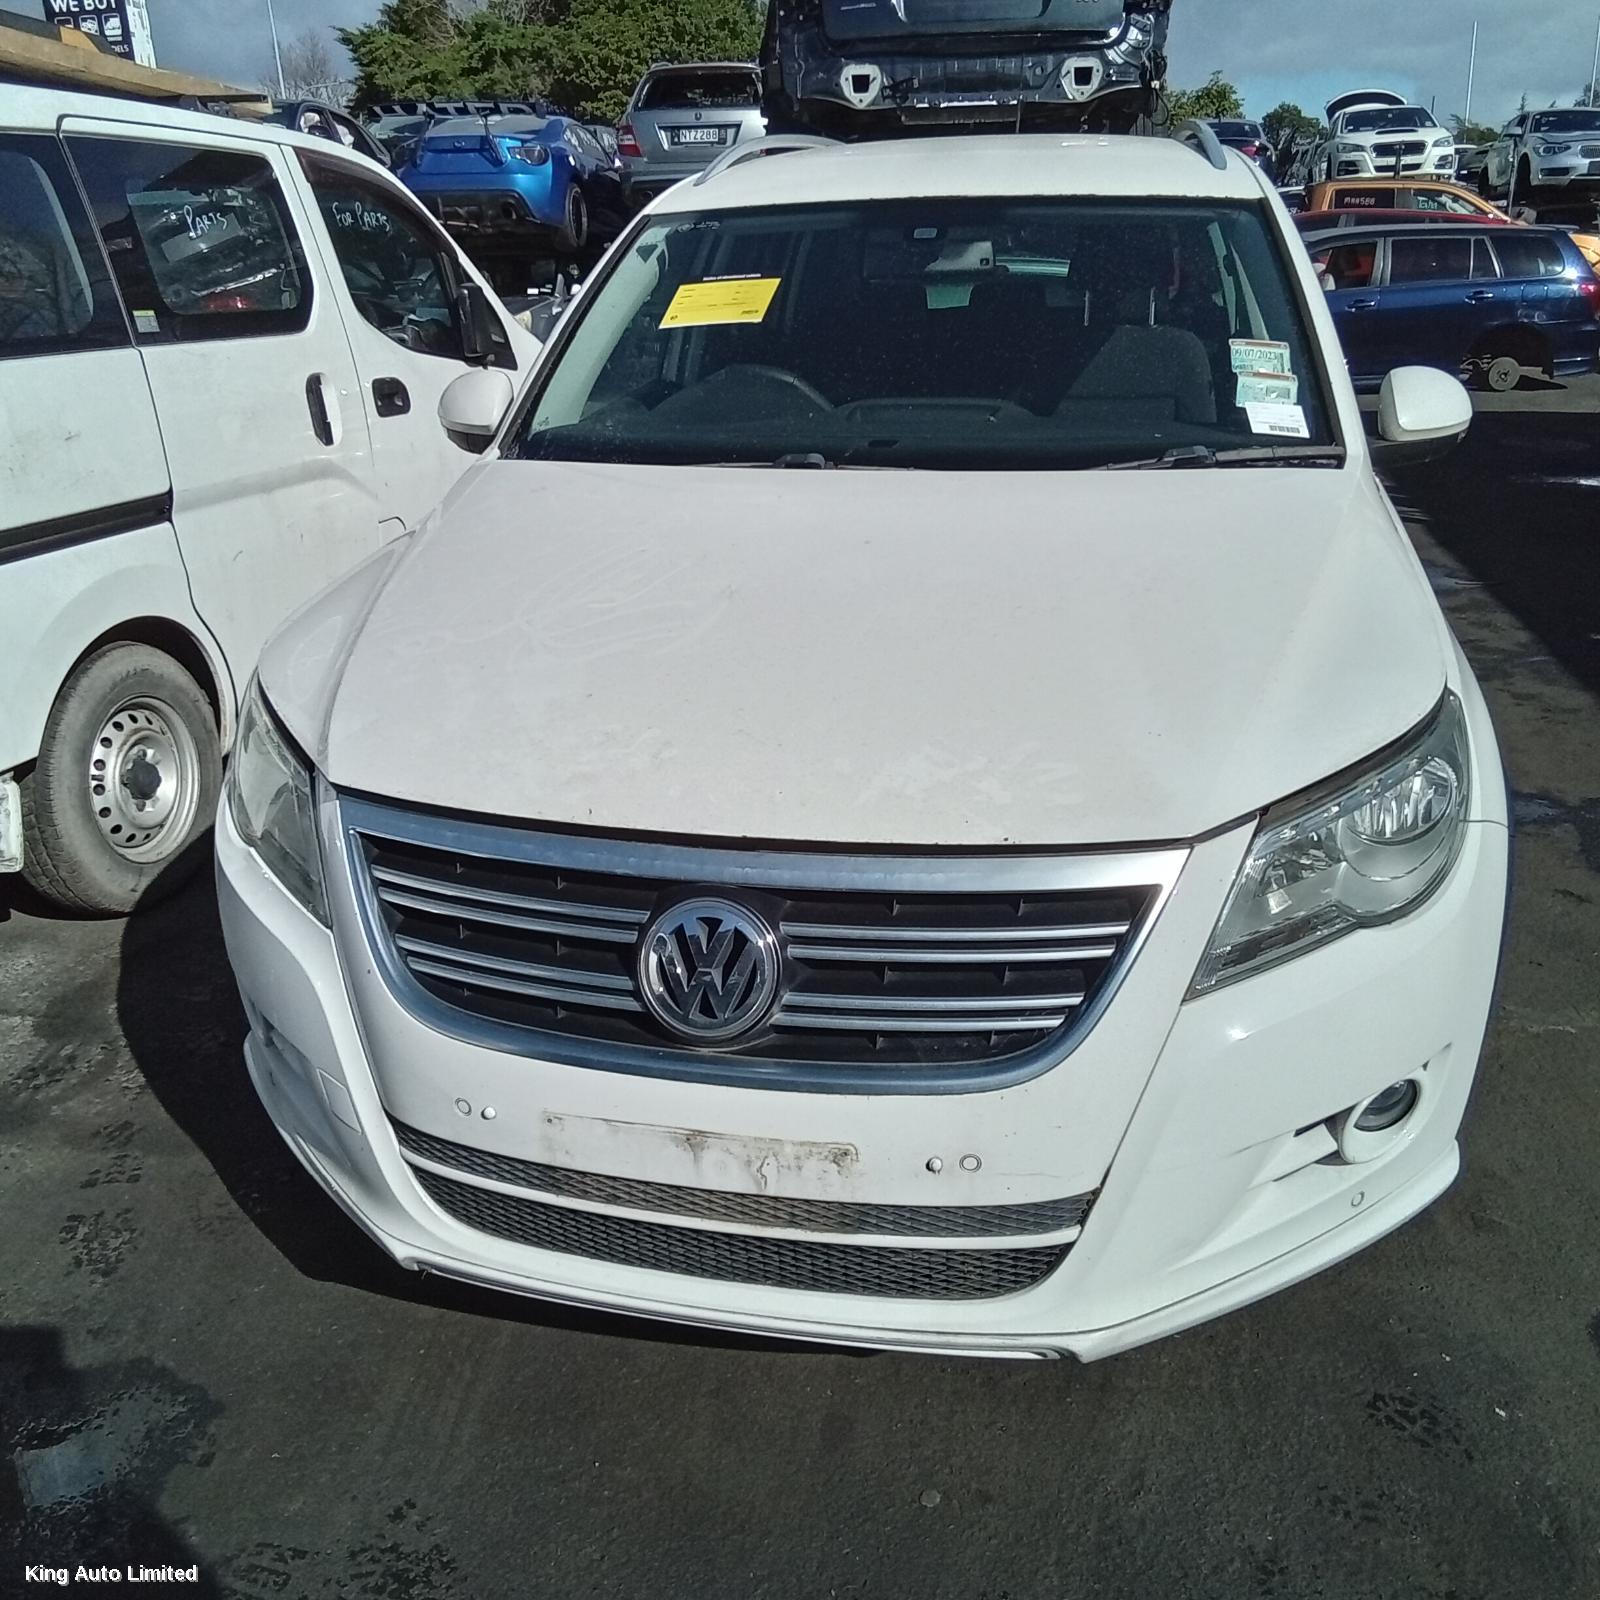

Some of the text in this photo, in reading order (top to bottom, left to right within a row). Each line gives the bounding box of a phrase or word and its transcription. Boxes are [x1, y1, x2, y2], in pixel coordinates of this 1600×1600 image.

[183, 204, 228, 238] PARTS
[332, 201, 390, 232] FOR PARTS
